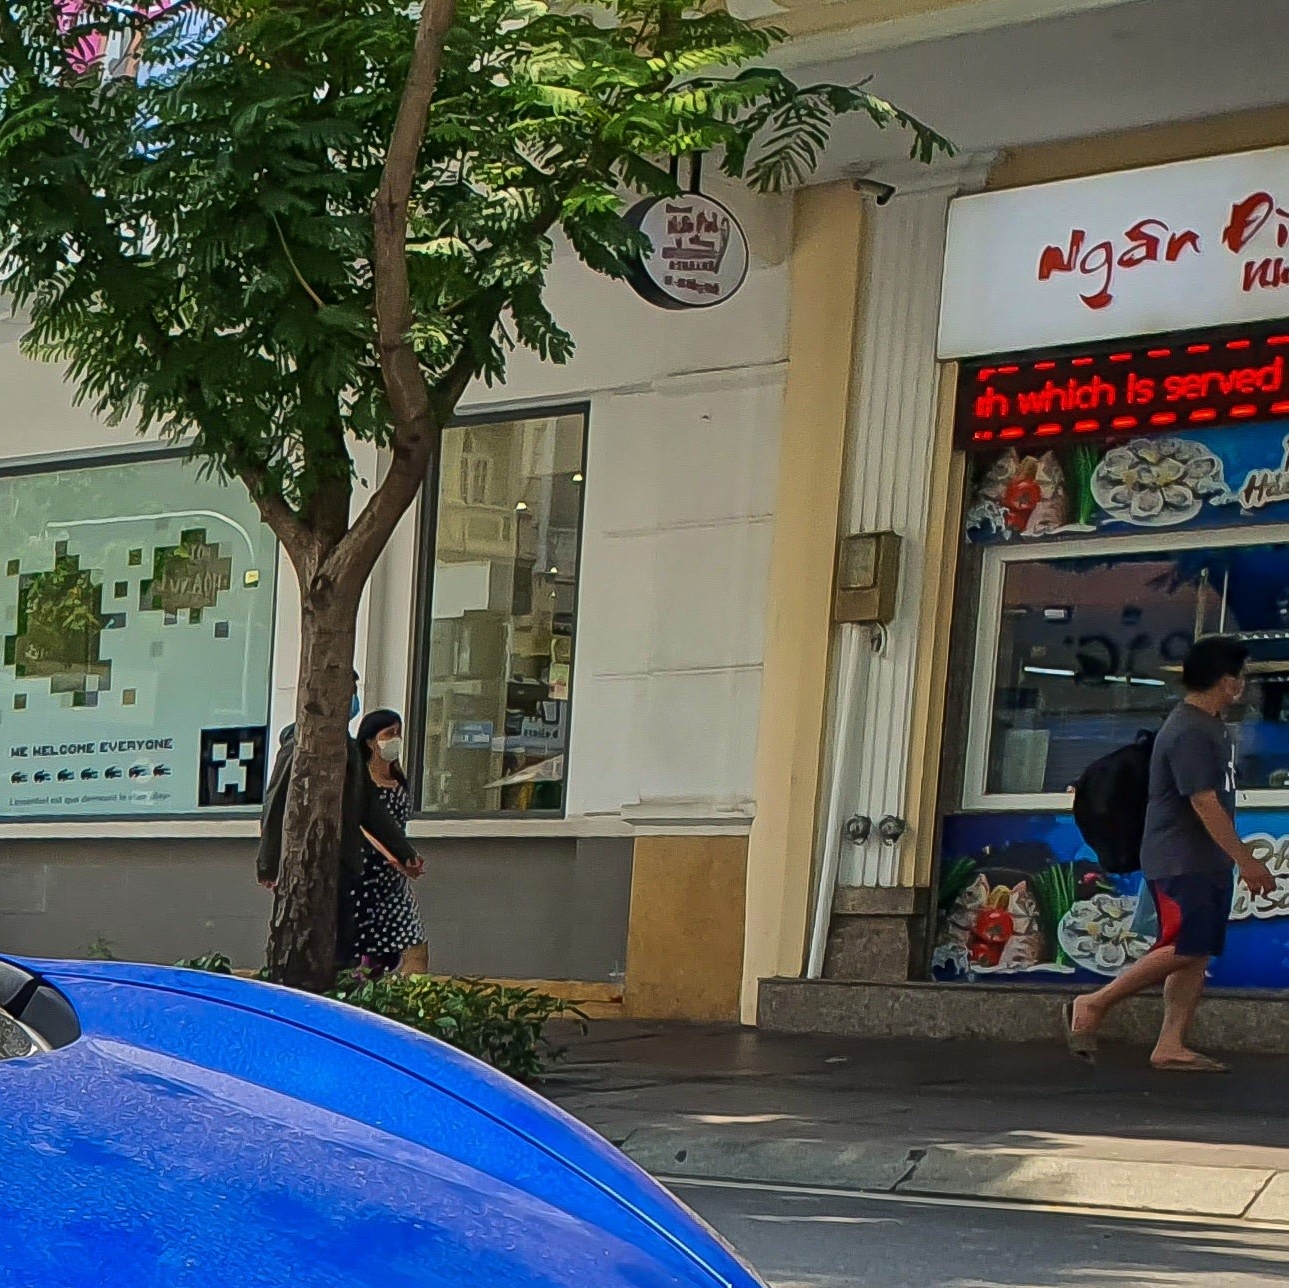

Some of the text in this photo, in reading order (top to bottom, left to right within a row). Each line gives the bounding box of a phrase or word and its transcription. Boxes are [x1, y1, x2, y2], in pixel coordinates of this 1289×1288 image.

[1037, 217, 1201, 310] Ngân
[1017, 375, 1116, 414] which
[1164, 355, 1284, 401] served
[33, 742, 96, 756] WELCOME
[99, 738, 173, 753] EVERYONE
